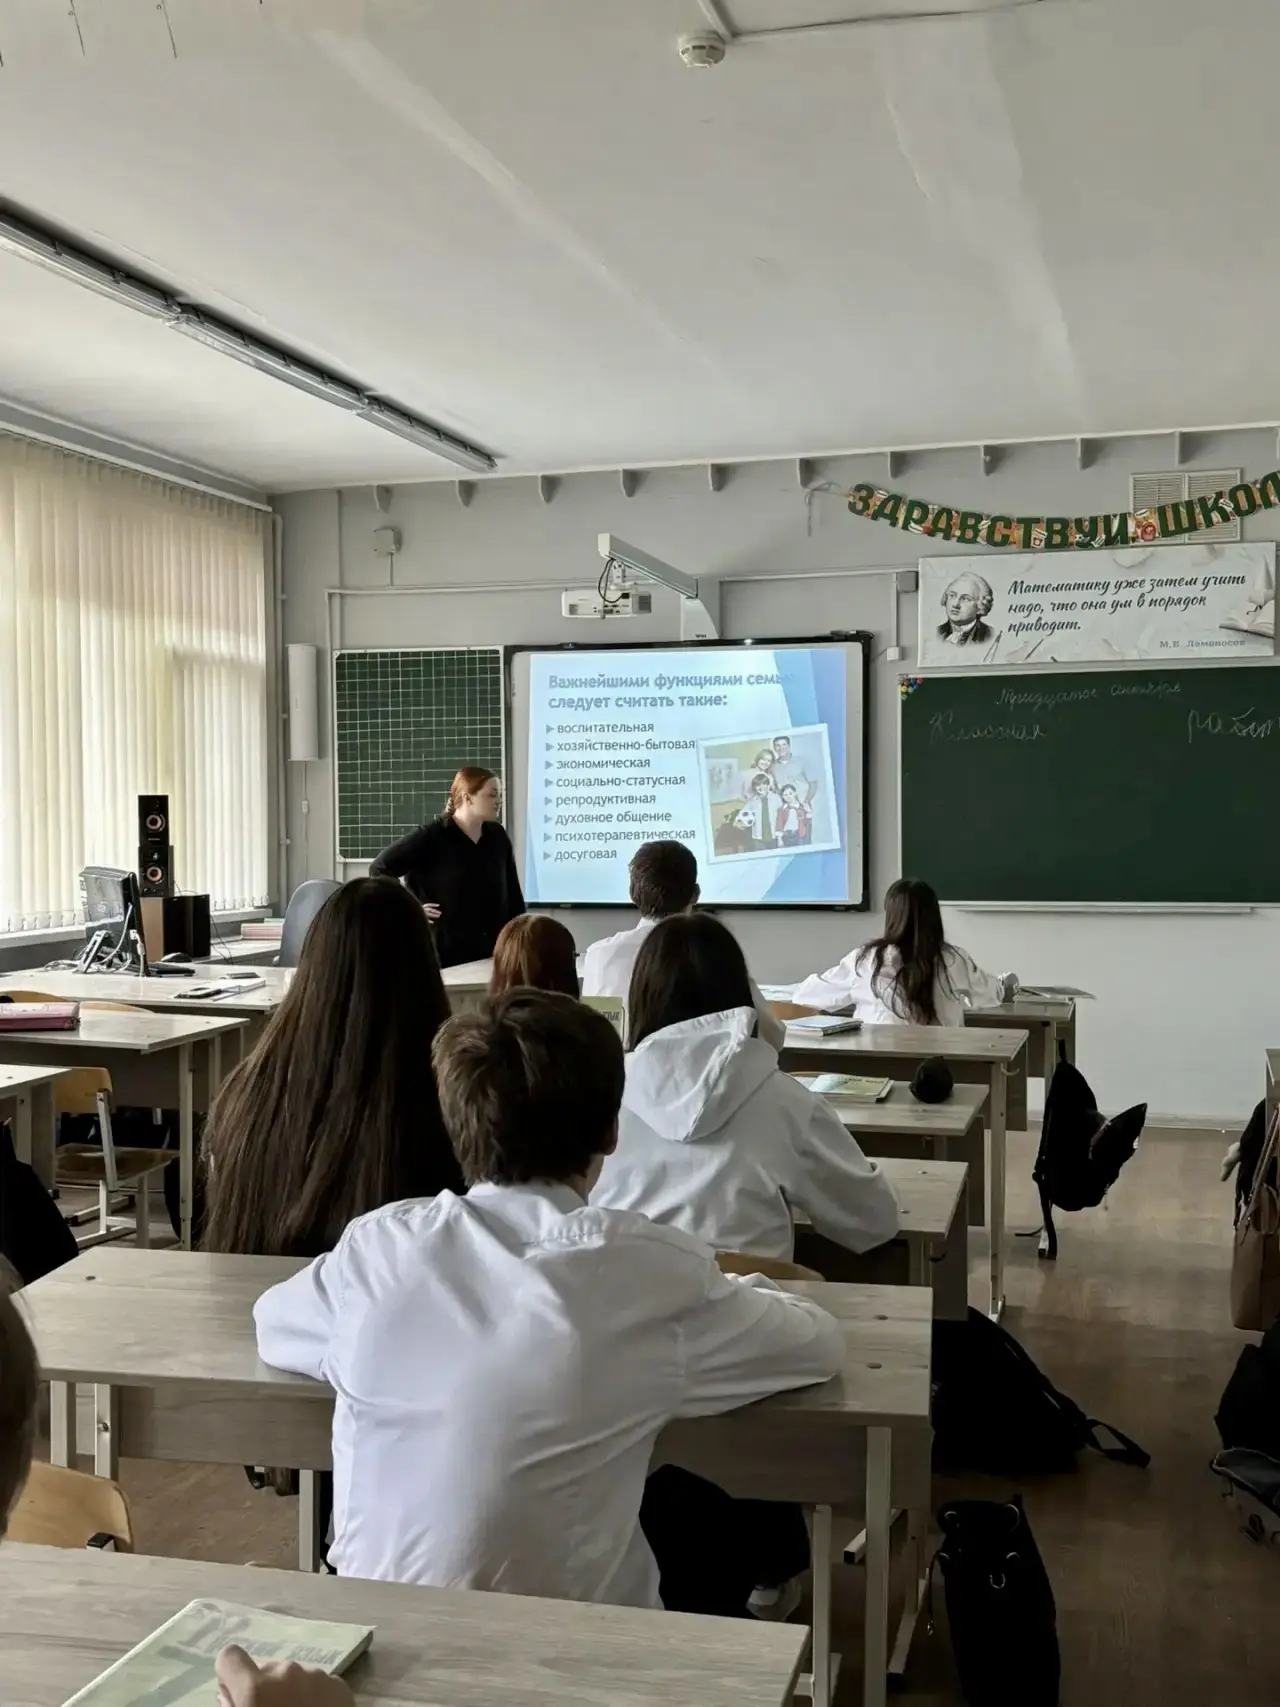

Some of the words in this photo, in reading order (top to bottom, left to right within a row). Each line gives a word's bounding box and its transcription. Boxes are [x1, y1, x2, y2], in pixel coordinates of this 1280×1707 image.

[1008, 579, 1110, 596] Математику
[1111, 578, 1146, 595] уже
[1149, 576, 1198, 594] затем
[1201, 574, 1247, 592] учить
[1008, 601, 1044, 619] надо,
[1050, 601, 1077, 612] что
[1081, 600, 1108, 611] она
[1109, 599, 1132, 615] ум
[1136, 592, 1146, 608] в
[1148, 595, 1206, 612] порядок
[1008, 617, 1081, 637] приводит.
[549, 672, 649, 688] Важнейшими
[654, 672, 743, 690] функциями
[548, 697, 610, 711] следует
[615, 696, 675, 708] считать
[679, 694, 728, 707] такие:
[557, 723, 654, 734] воспитательная
[557, 738, 696, 751] хозяйственно-бытовая
[556, 758, 651, 770] экономическая
[556, 775, 686, 788] социально-статусная
[556, 794, 656, 807] репродуктивная
[555, 813, 613, 826] духовное
[616, 811, 672, 824] общение
[555, 830, 696, 843] психотерапевтическая
[555, 849, 617, 862] досуговая
